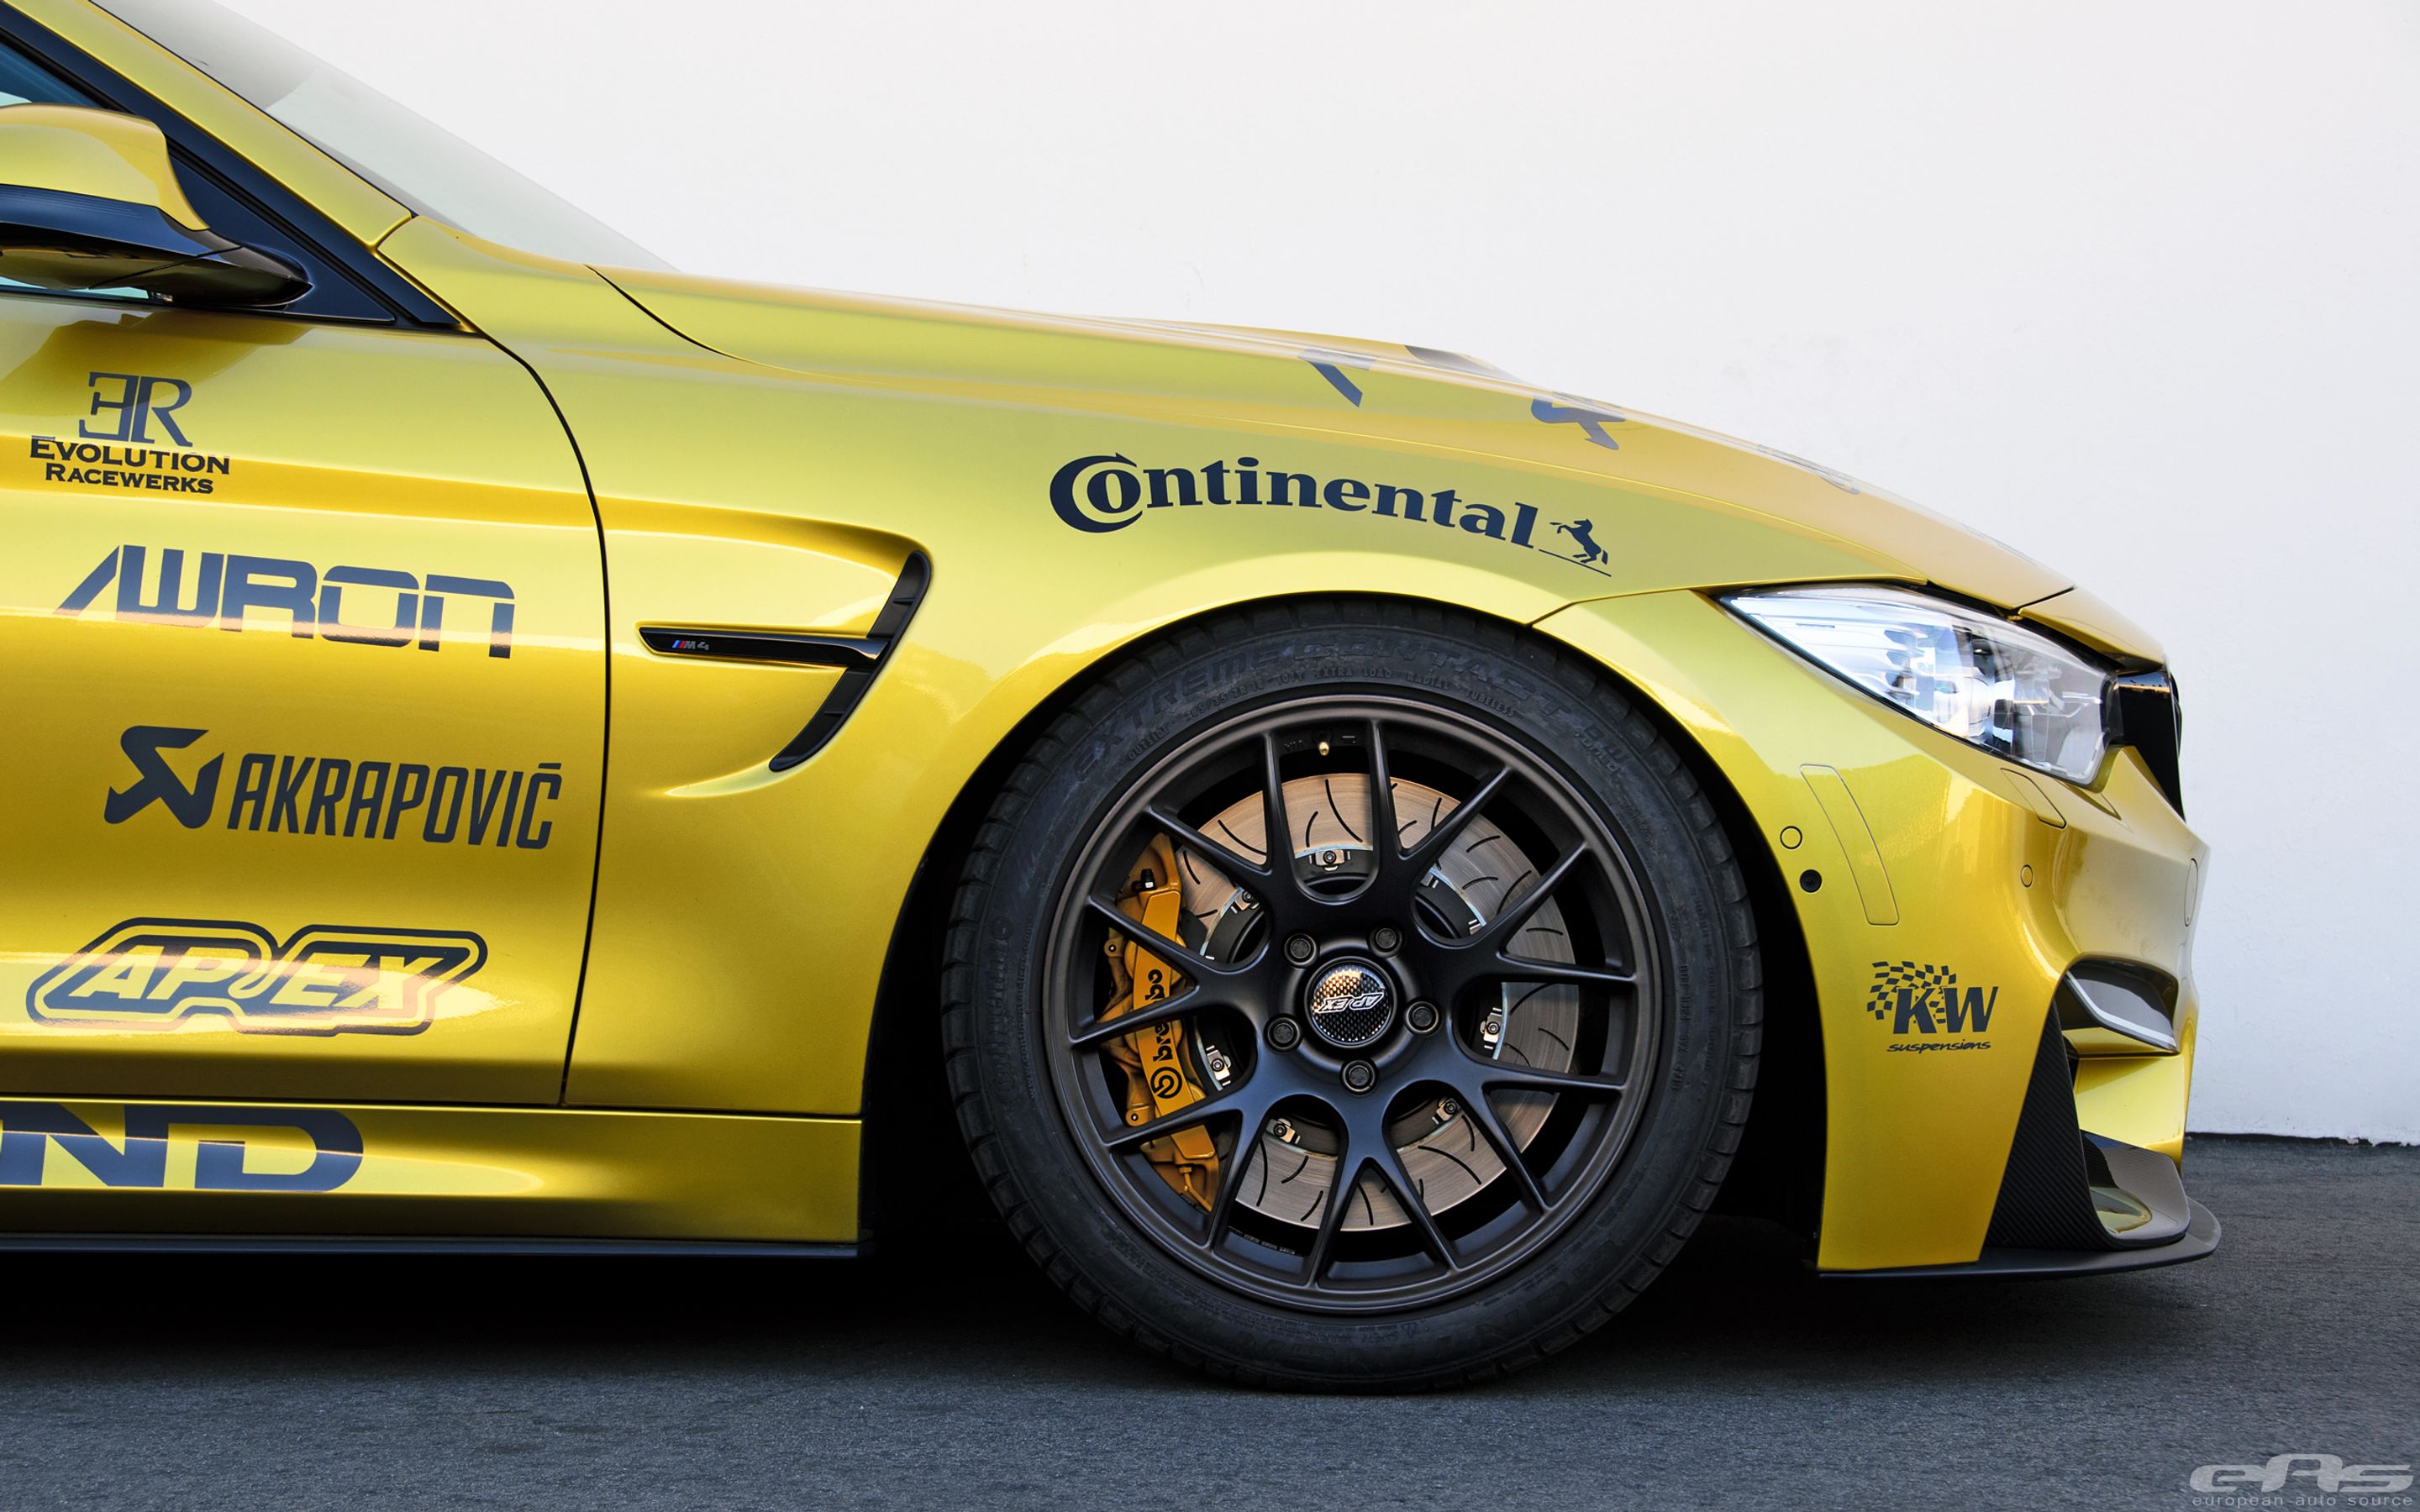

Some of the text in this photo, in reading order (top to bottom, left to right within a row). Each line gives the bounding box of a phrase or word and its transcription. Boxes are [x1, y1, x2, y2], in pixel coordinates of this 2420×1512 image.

[30, 435, 229, 475] EVOLUTION
[45, 463, 214, 494] RACEWERKS
[1050, 453, 1539, 549] Continental
[1317, 667, 1392, 680] EXTRA LOAD
[1407, 672, 1449, 691] RADIAL
[1465, 688, 1519, 718] TUBELESS
[1128, 725, 1171, 760] OUTSIDE
[44, 934, 471, 1014] APEX
[1144, 969, 1174, 1063] brebo
[1893, 986, 1999, 1034] KW
[1887, 1038, 1991, 1054] suspensions
